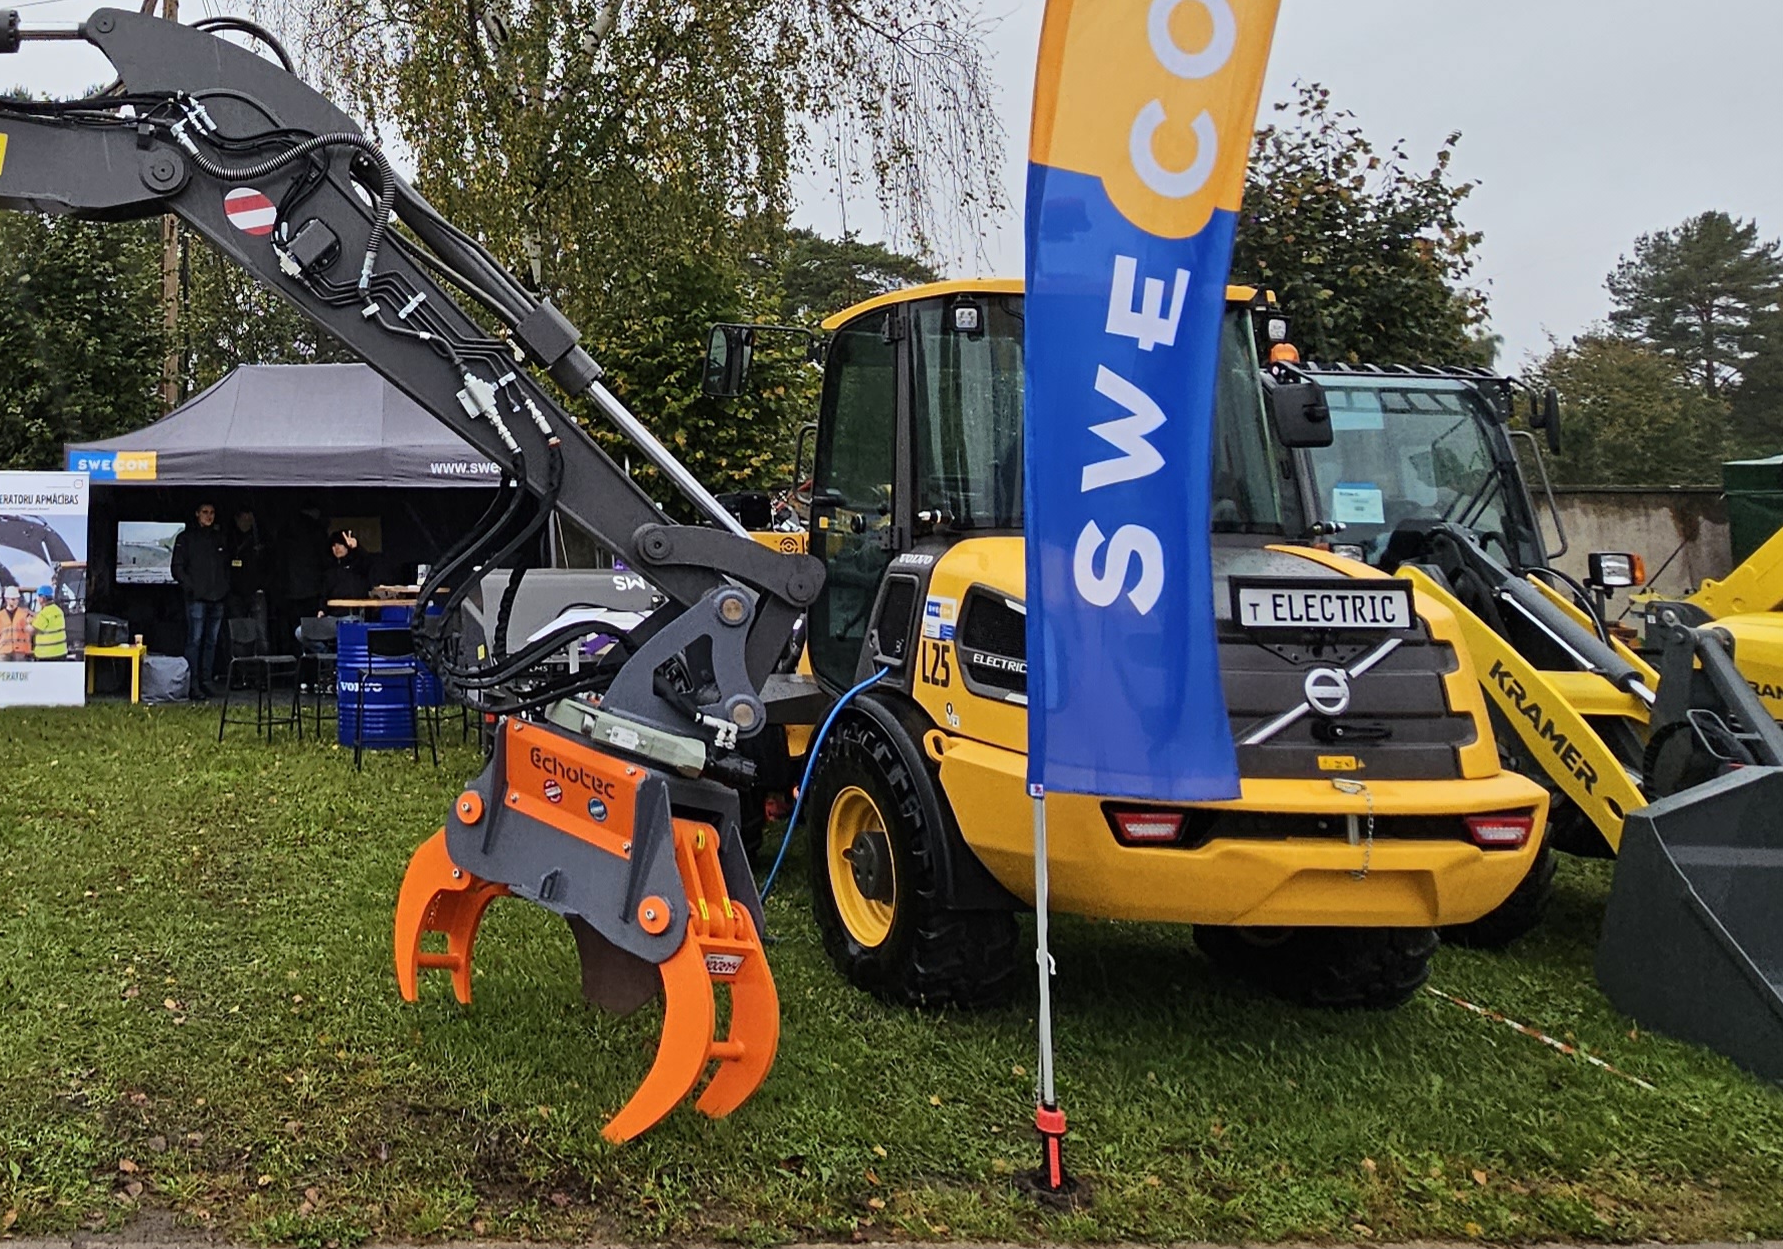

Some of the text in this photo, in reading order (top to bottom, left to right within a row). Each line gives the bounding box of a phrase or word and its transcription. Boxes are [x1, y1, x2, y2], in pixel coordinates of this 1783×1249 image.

[78, 458, 149, 471] SWECON
[430, 462, 503, 474] www.swe
[899, 553, 934, 565] VOLVO
[1249, 594, 1396, 624] T ELECTRIC
[922, 640, 951, 689] L25
[973, 653, 1028, 674] ELECTRIC
[1488, 658, 1598, 796] KRAMER
